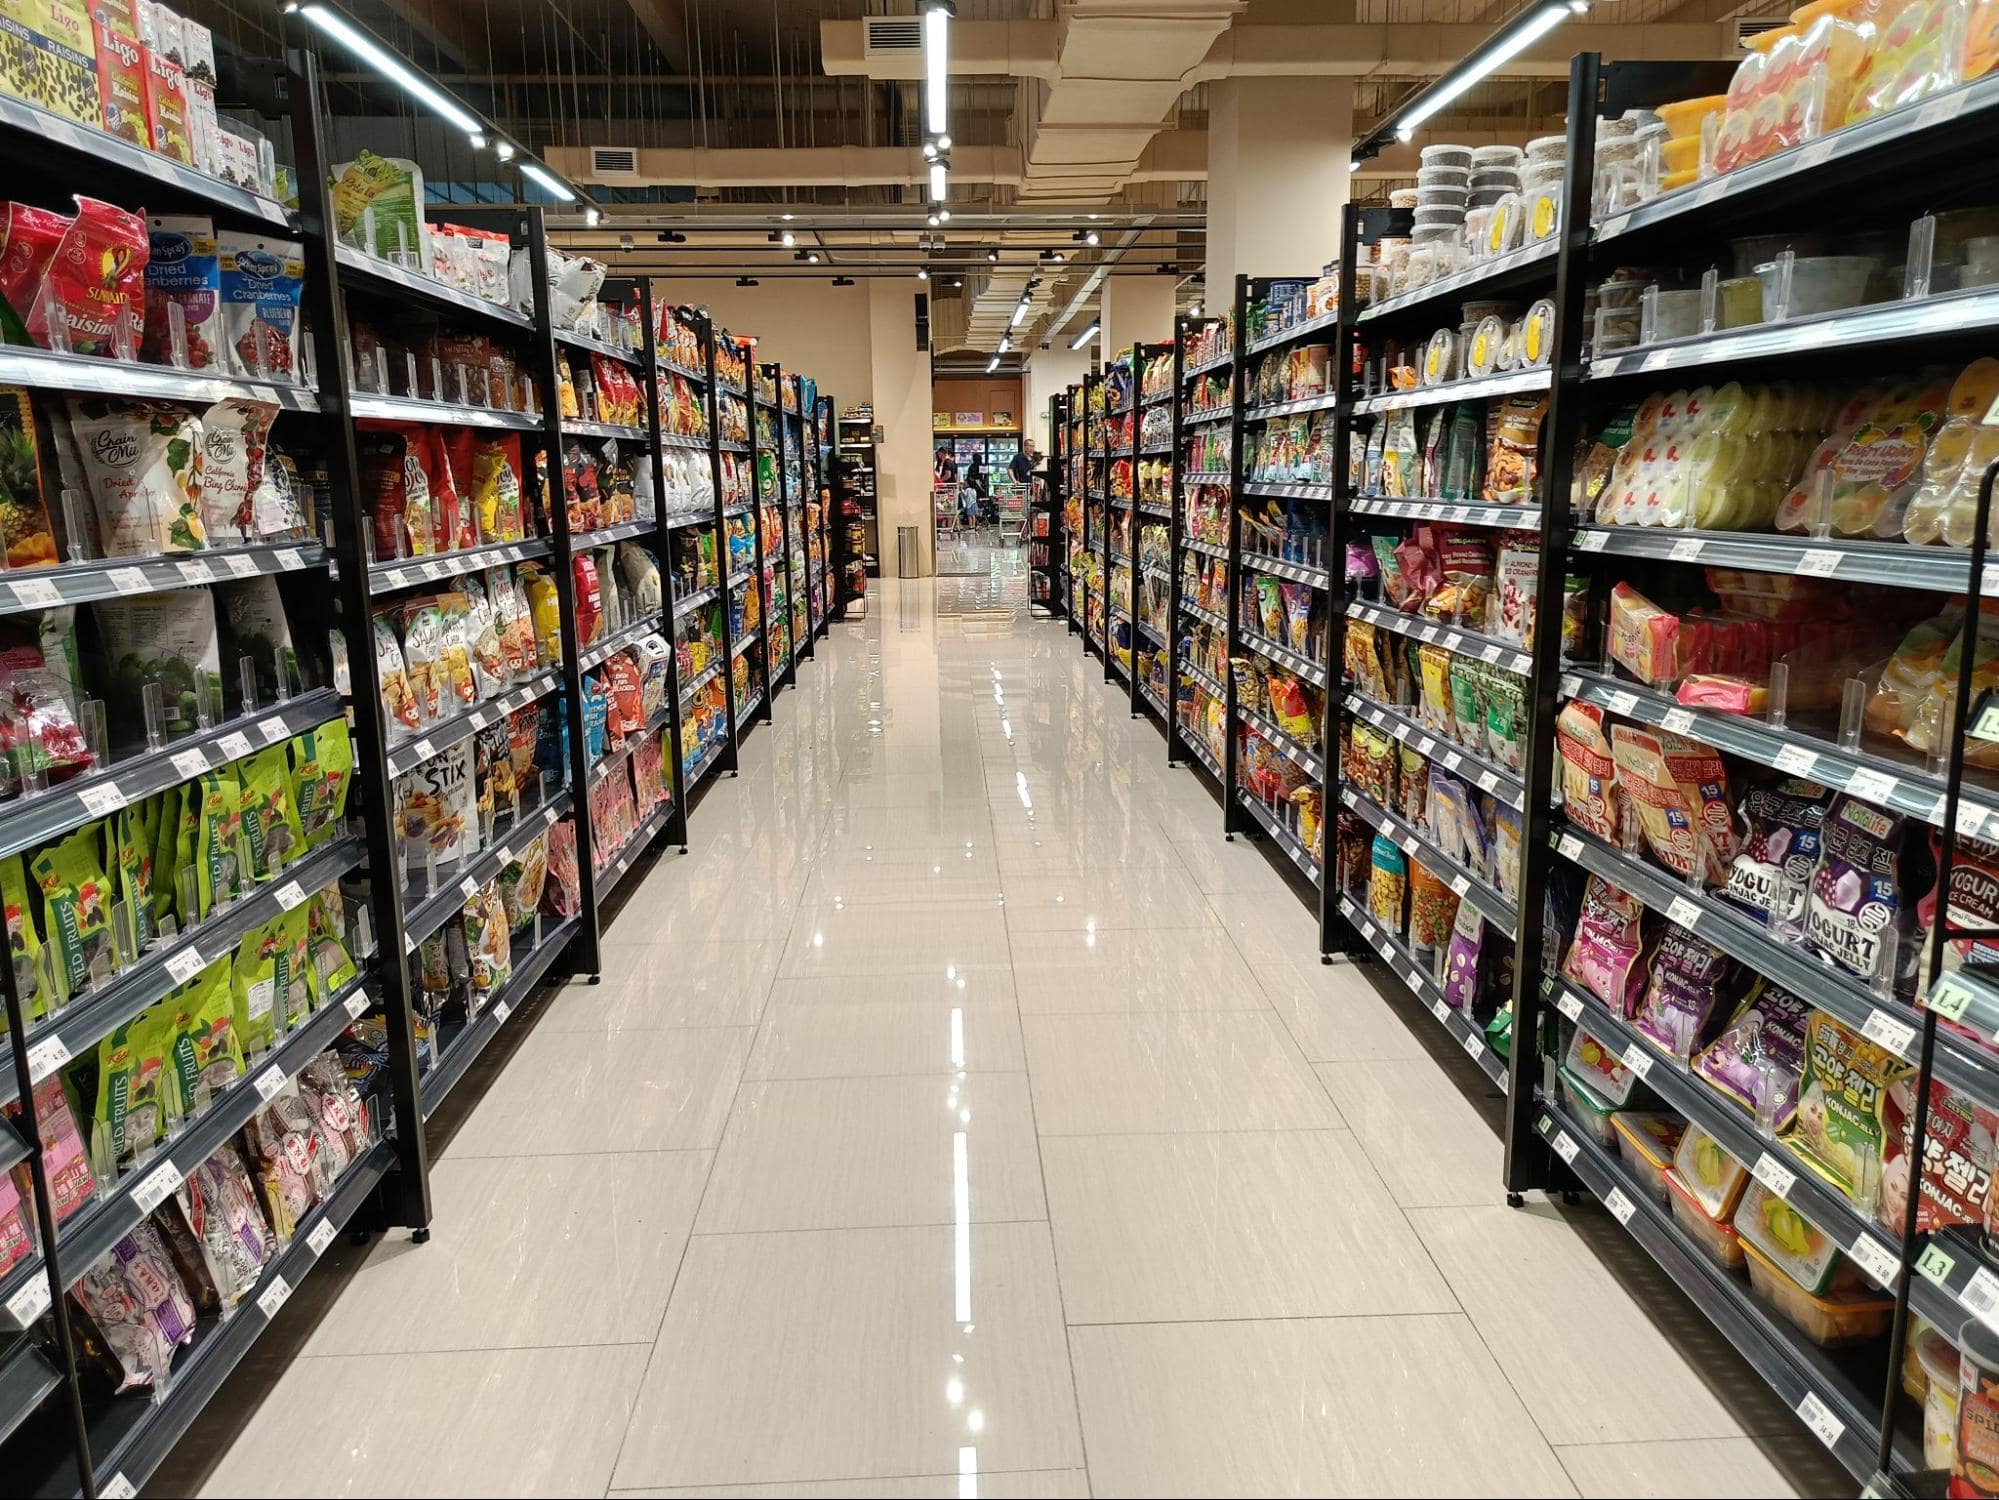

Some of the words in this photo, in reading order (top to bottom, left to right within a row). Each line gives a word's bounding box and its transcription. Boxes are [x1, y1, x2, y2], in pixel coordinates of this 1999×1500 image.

[49, 4, 79, 32] Ligo
[47, 41, 89, 68] RAISINS
[101, 27, 140, 67] Ligo
[150, 54, 181, 90] Ligo
[232, 289, 292, 303] Cranberries
[249, 280, 274, 291] Dried
[98, 429, 137, 452] Grain
[104, 474, 136, 489] Dried
[203, 475, 223, 494] Bing
[205, 465, 235, 480] California
[424, 758, 466, 796] STIX
[1590, 779, 1600, 792] 15
[301, 783, 314, 819] FRUITS
[1701, 785, 1719, 797] 15
[245, 810, 263, 850] FRUITS
[1669, 811, 1685, 823] 15
[1844, 803, 1889, 837] Natalife
[211, 819, 220, 862] FRUITS
[1800, 834, 1817, 850] 15
[1730, 865, 1803, 907] YOGUT
[1874, 880, 1893, 897] 15
[1950, 870, 1999, 909] YOGUR
[1959, 892, 1994, 920] CREAM
[59, 900, 81, 950] FRUITS
[1811, 911, 1876, 963] OGURT
[275, 953, 289, 990] FRUITS
[1836, 948, 1872, 973] JELLY
[1664, 971, 1689, 990] KONJAC
[1937, 987, 1961, 1013] L4
[1764, 1022, 1802, 1048] KONJAC
[181, 1037, 197, 1081] FRUITS
[115, 1074, 129, 1119] FRUITS
[1824, 1094, 1860, 1126] KONJAC
[1922, 1251, 1946, 1277] L3
